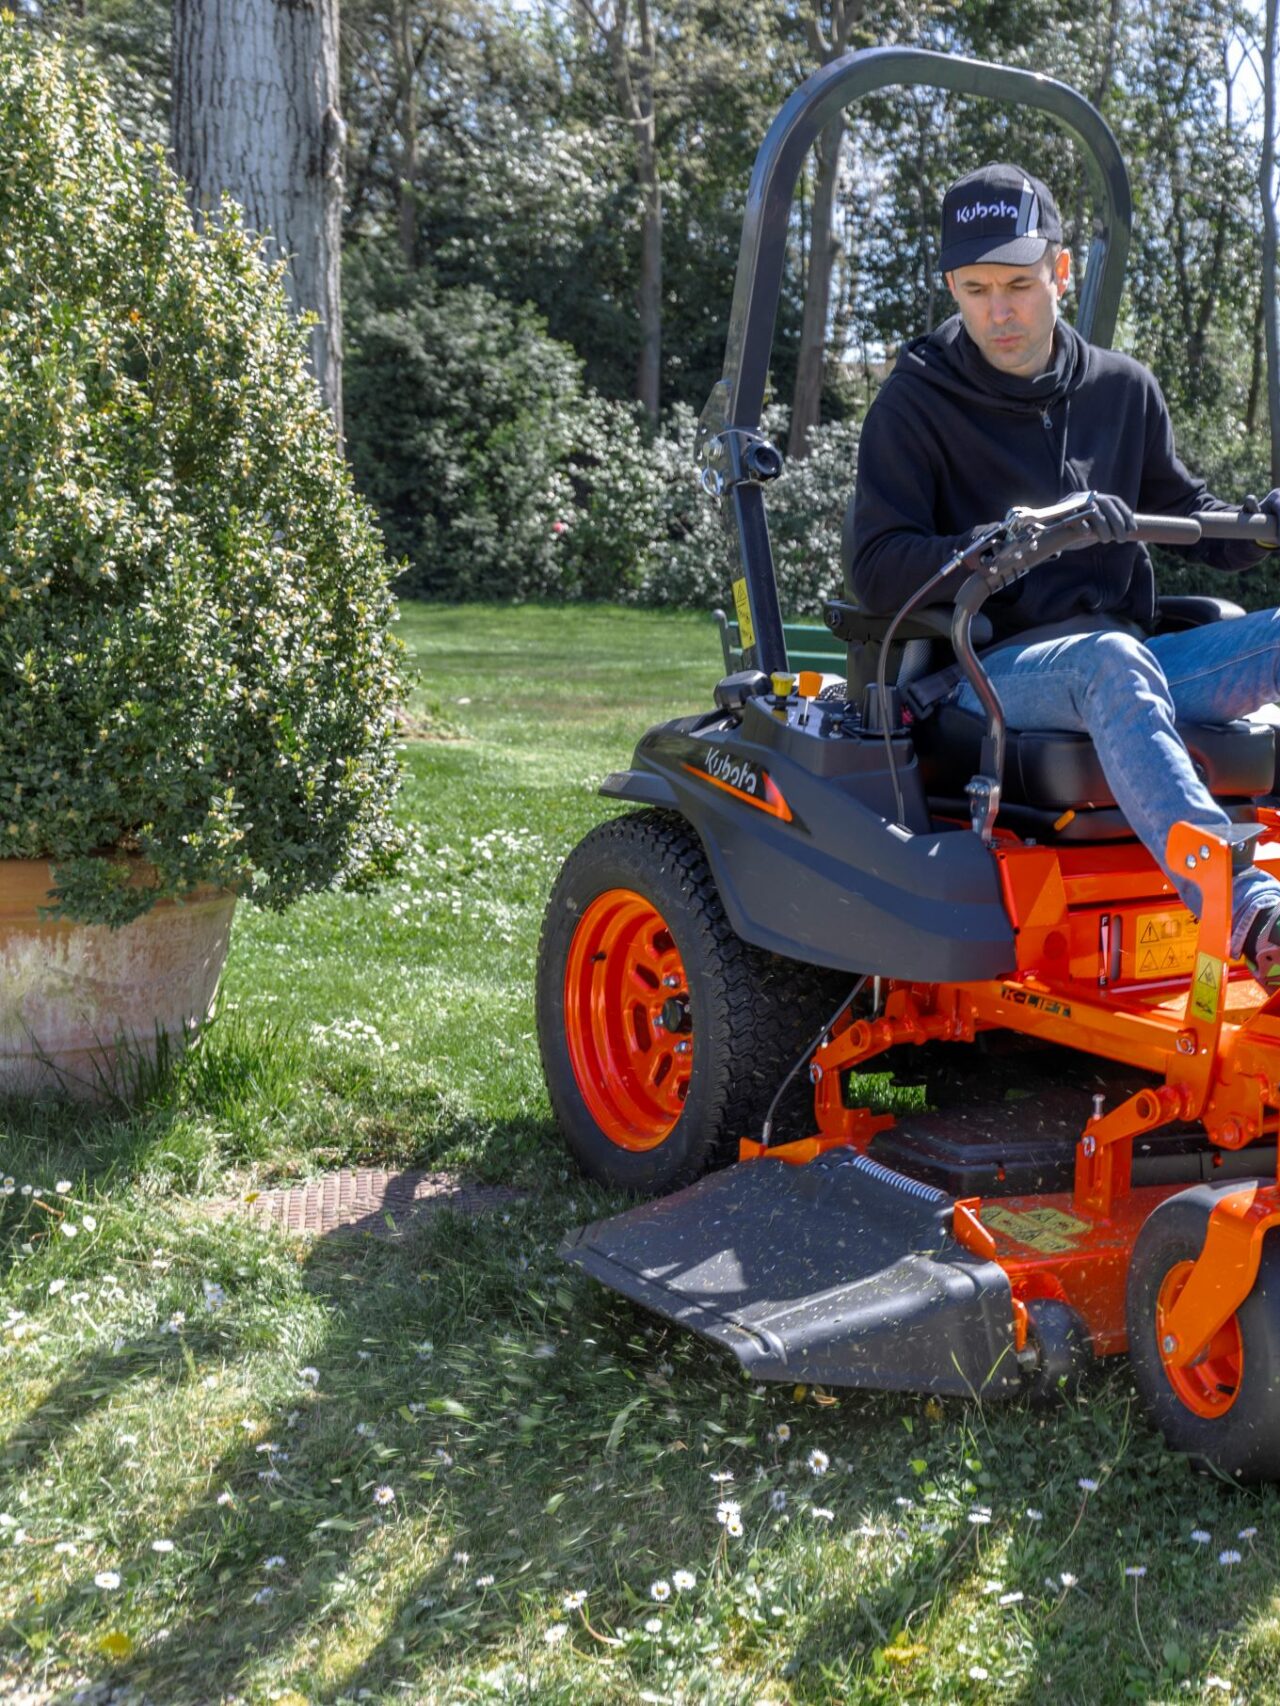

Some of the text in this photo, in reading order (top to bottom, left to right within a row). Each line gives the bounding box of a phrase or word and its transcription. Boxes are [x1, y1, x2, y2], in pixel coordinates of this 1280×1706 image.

[956, 200, 1018, 223] Kubota
[705, 747, 757, 794] Kubota
[1002, 988, 1071, 1017] K-LIFT
